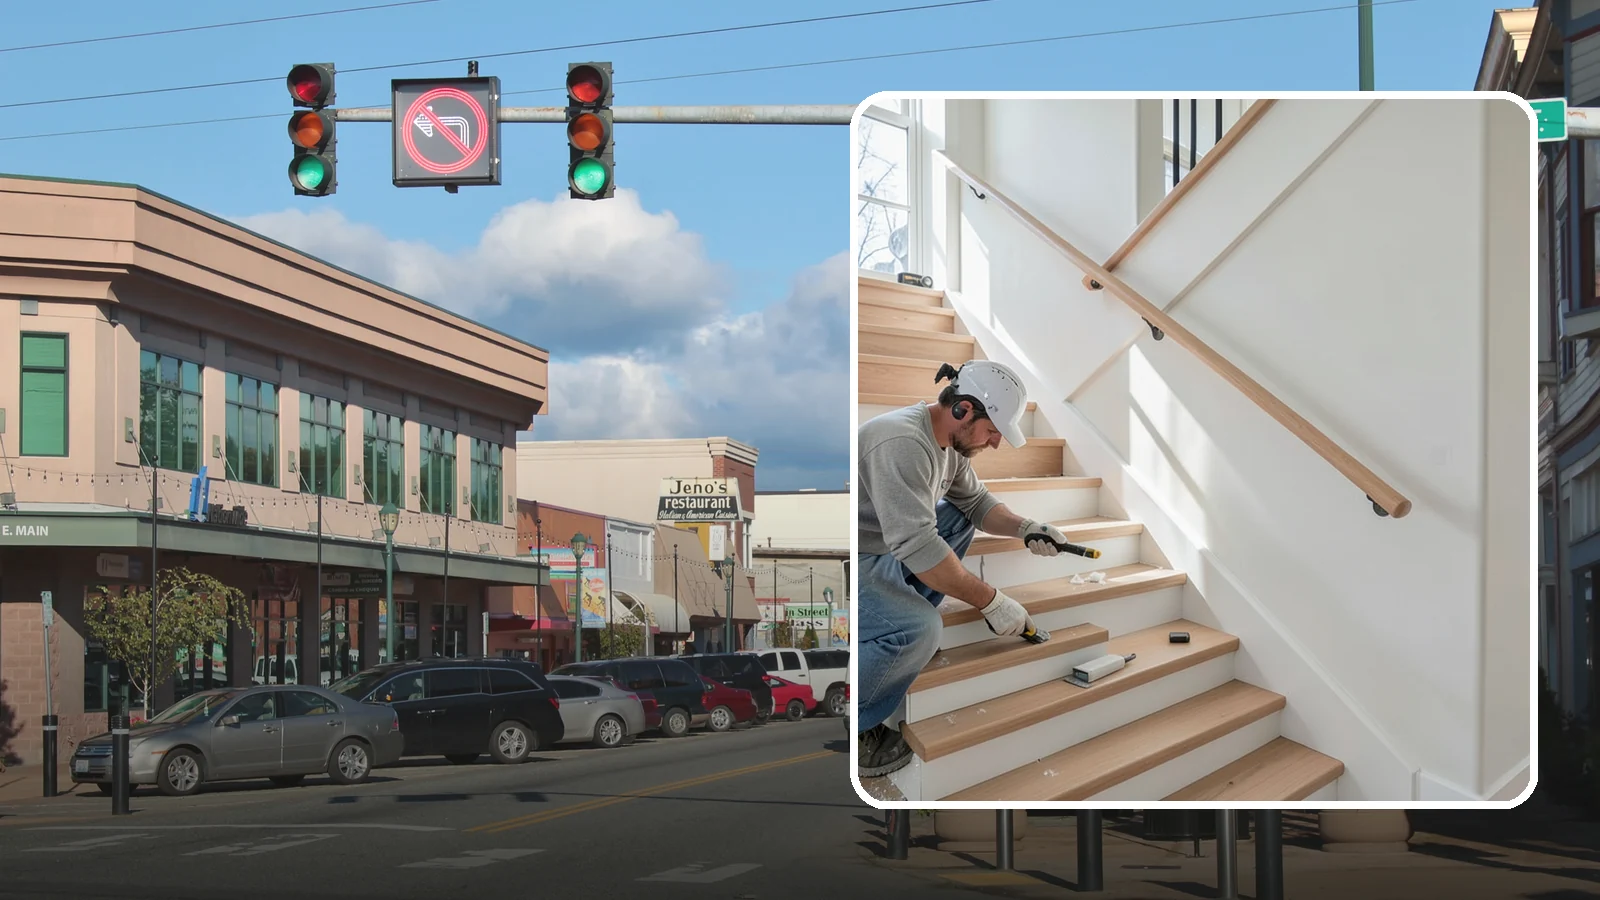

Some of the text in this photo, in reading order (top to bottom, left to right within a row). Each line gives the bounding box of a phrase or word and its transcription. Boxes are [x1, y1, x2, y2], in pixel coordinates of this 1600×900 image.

[669, 480, 728, 495] Jeno's
[665, 496, 731, 509] restaurant
[715, 509, 737, 519] Cuisine
[2, 525, 49, 536] E. MAIN
[797, 607, 828, 617] Street
